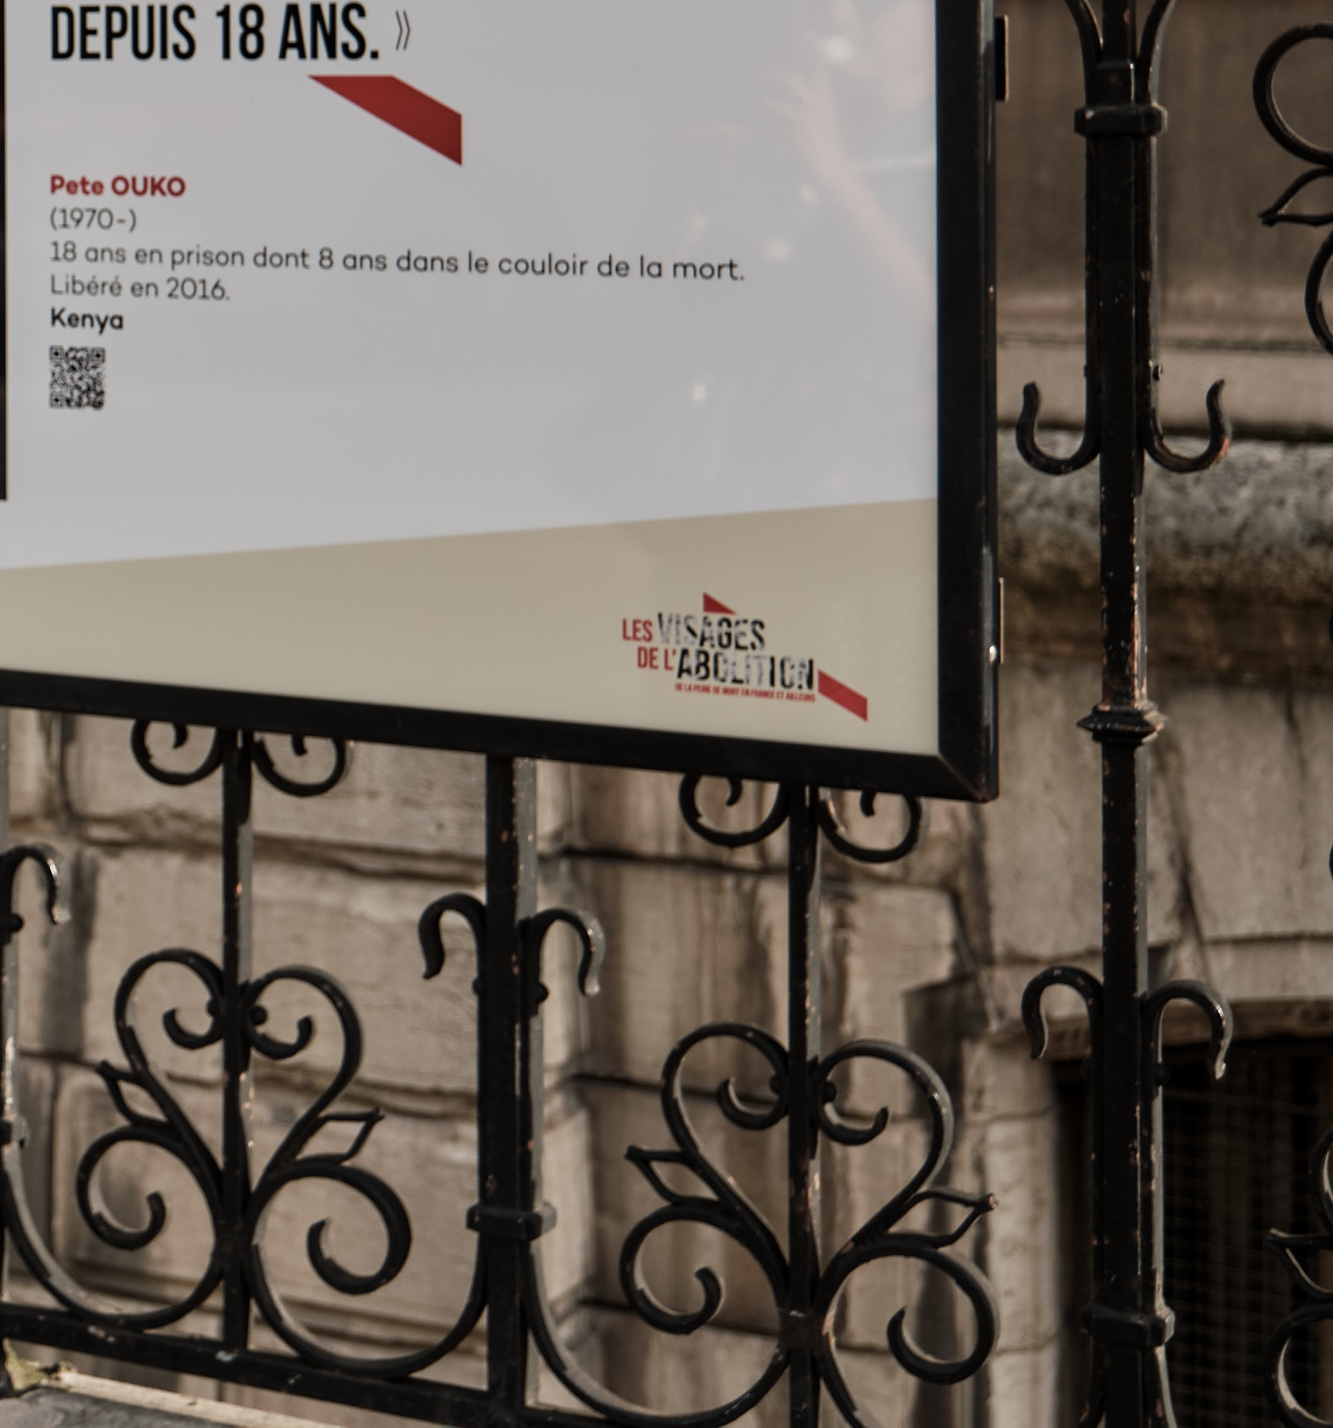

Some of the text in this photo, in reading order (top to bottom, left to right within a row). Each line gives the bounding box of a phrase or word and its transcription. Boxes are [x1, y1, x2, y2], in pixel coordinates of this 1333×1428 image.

[50, 3, 197, 61] DEPUIS
[215, 2, 265, 61] 18
[278, 1, 380, 61] ANS.
[50, 174, 187, 199] Pete OUKO
[49, 206, 137, 233] (1970-)
[50, 239, 745, 281] 18 ans en prison dont 8 ans dans le couloir de la mort.
[50, 273, 230, 301] Libéré en 2016.
[50, 307, 124, 336] Kenya
[622, 612, 766, 651] LES VISAGES
[637, 646, 659, 669] DE
